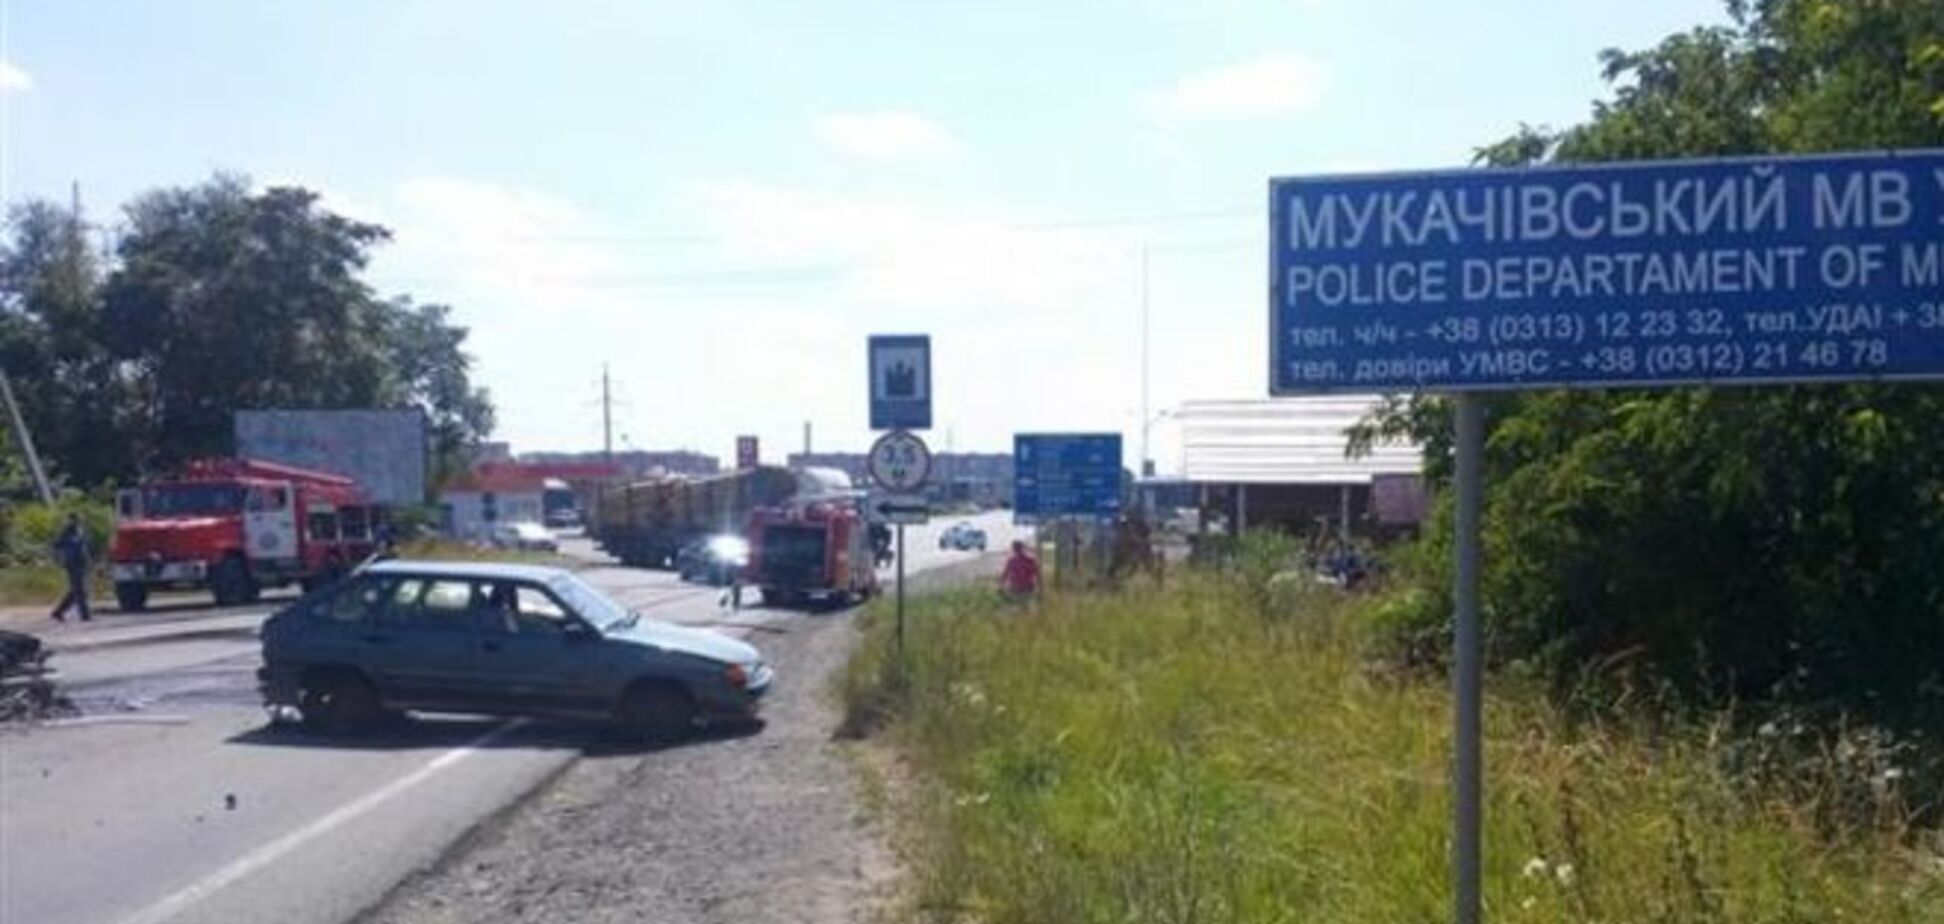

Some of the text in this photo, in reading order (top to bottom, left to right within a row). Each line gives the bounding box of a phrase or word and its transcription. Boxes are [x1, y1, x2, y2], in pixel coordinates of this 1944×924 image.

[1289, 166, 1787, 249] МУКАЧІВСЬКИЙ
[1813, 170, 1912, 229] МВ
[1287, 242, 1944, 306] POLICE DEPARTAMENT OF M
[1291, 327, 1344, 348] тел.
[1489, 310, 1584, 342] (0313)
[1597, 311, 1631, 338] 12
[1640, 309, 1677, 336] 23
[1686, 306, 1733, 338] 32,
[1291, 359, 1344, 381] тел.
[1354, 348, 1449, 383] довіри
[1459, 349, 1549, 376] УМВС
[1581, 346, 1636, 373] +38
[1645, 341, 1744, 374] (0312)
[1753, 343, 1787, 370] 21
[1799, 342, 1839, 367] 46
[1851, 338, 1887, 366] 78
